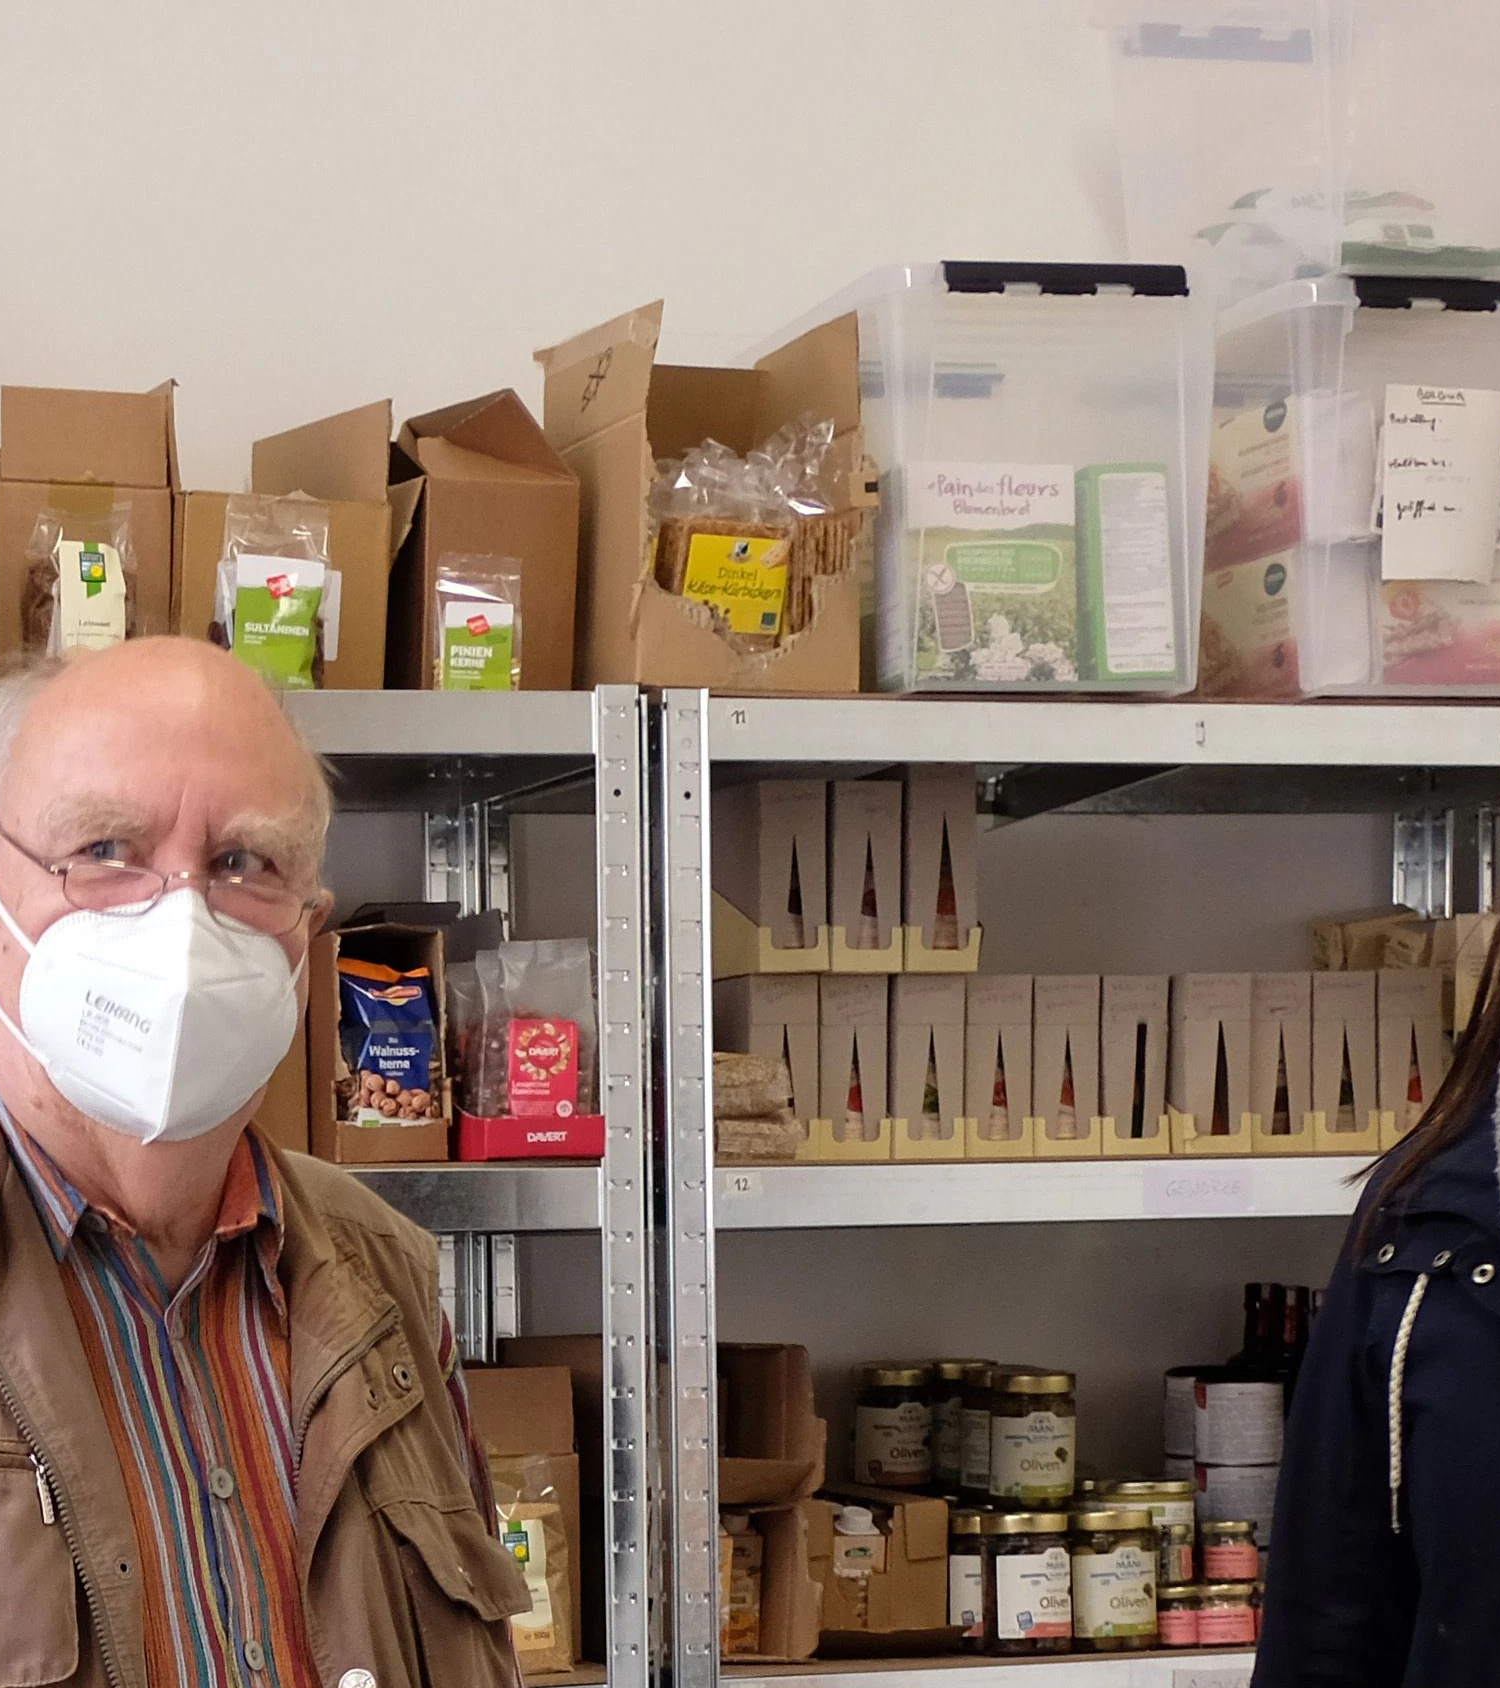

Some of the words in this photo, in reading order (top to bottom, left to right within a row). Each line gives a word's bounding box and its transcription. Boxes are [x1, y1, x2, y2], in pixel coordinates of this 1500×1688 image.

[937, 473, 973, 497] Pain
[997, 473, 1060, 497] fleurs
[243, 622, 309, 637] SULTANINEN
[449, 645, 493, 658] PINIEN
[368, 1045, 420, 1057] Walnuss-
[527, 1046, 560, 1057] DAVERT
[526, 1131, 568, 1142] DAVERT
[734, 1177, 751, 1192] 12
[1019, 1459, 1061, 1472] Oliven
[1109, 1596, 1149, 1610] Oliven
